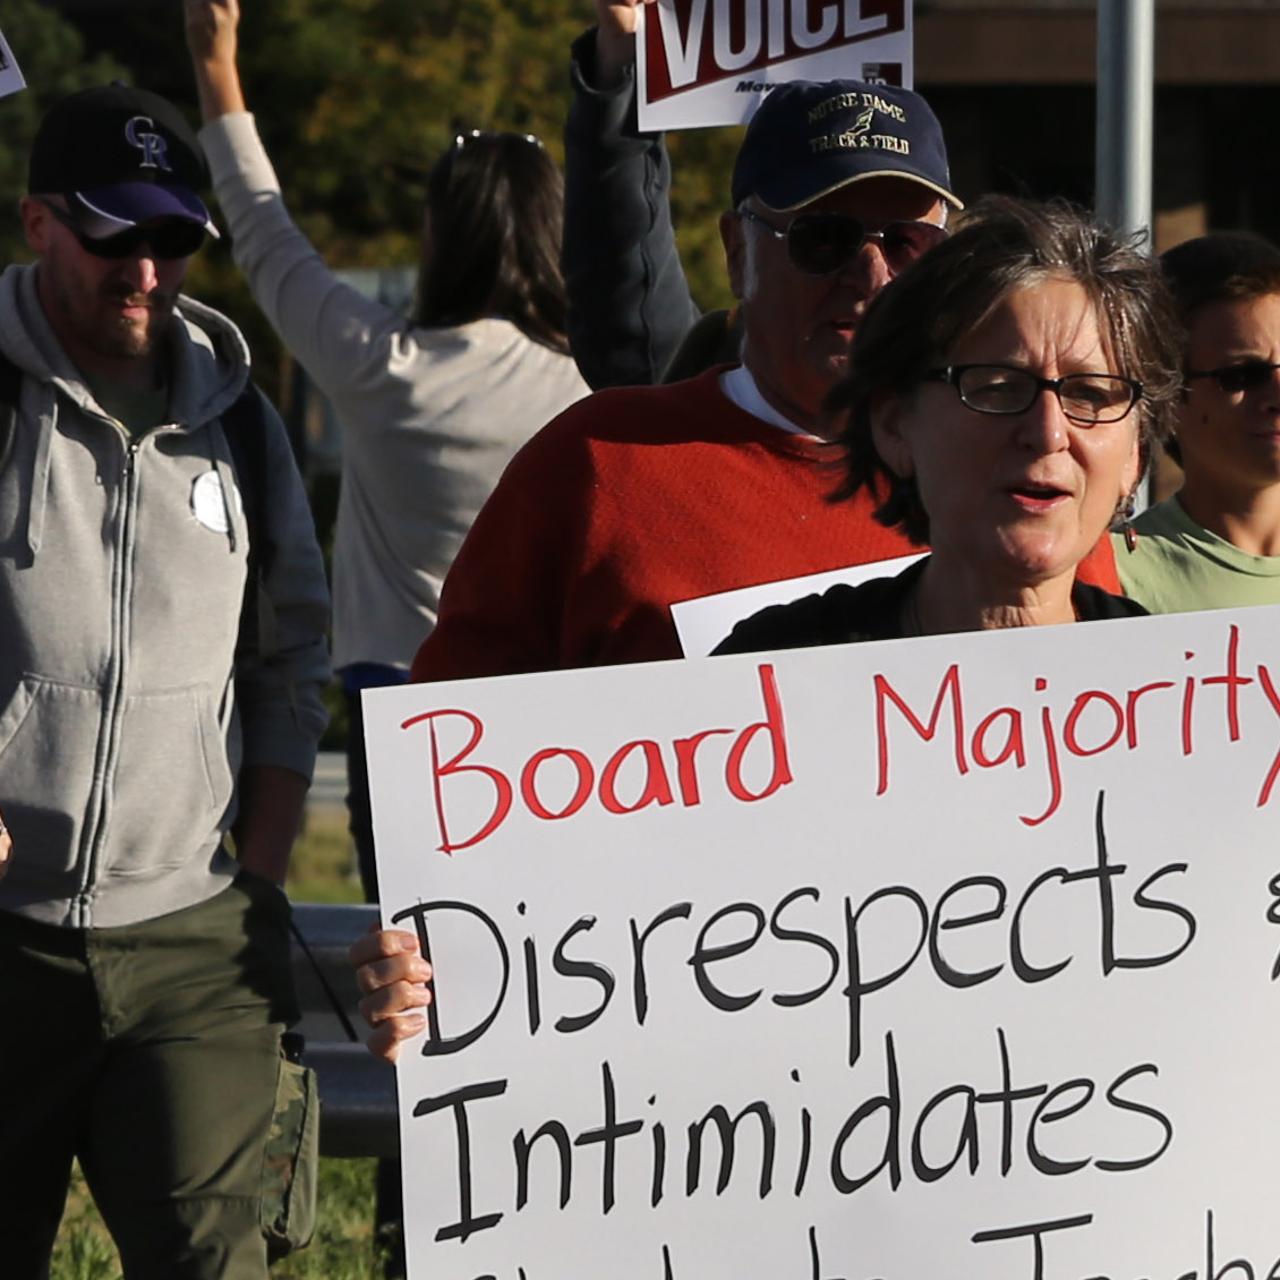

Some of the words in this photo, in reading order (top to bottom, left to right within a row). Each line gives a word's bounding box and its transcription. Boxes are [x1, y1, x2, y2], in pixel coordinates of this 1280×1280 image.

[809, 134, 857, 154] TRACK
[860, 137, 870, 148] &
[872, 134, 911, 155] FIELD
[862, 93, 907, 123] DAME
[400, 662, 794, 858] Board
[391, 790, 1199, 1068] Disrespects
[411, 1026, 1175, 1245] Intimidates
